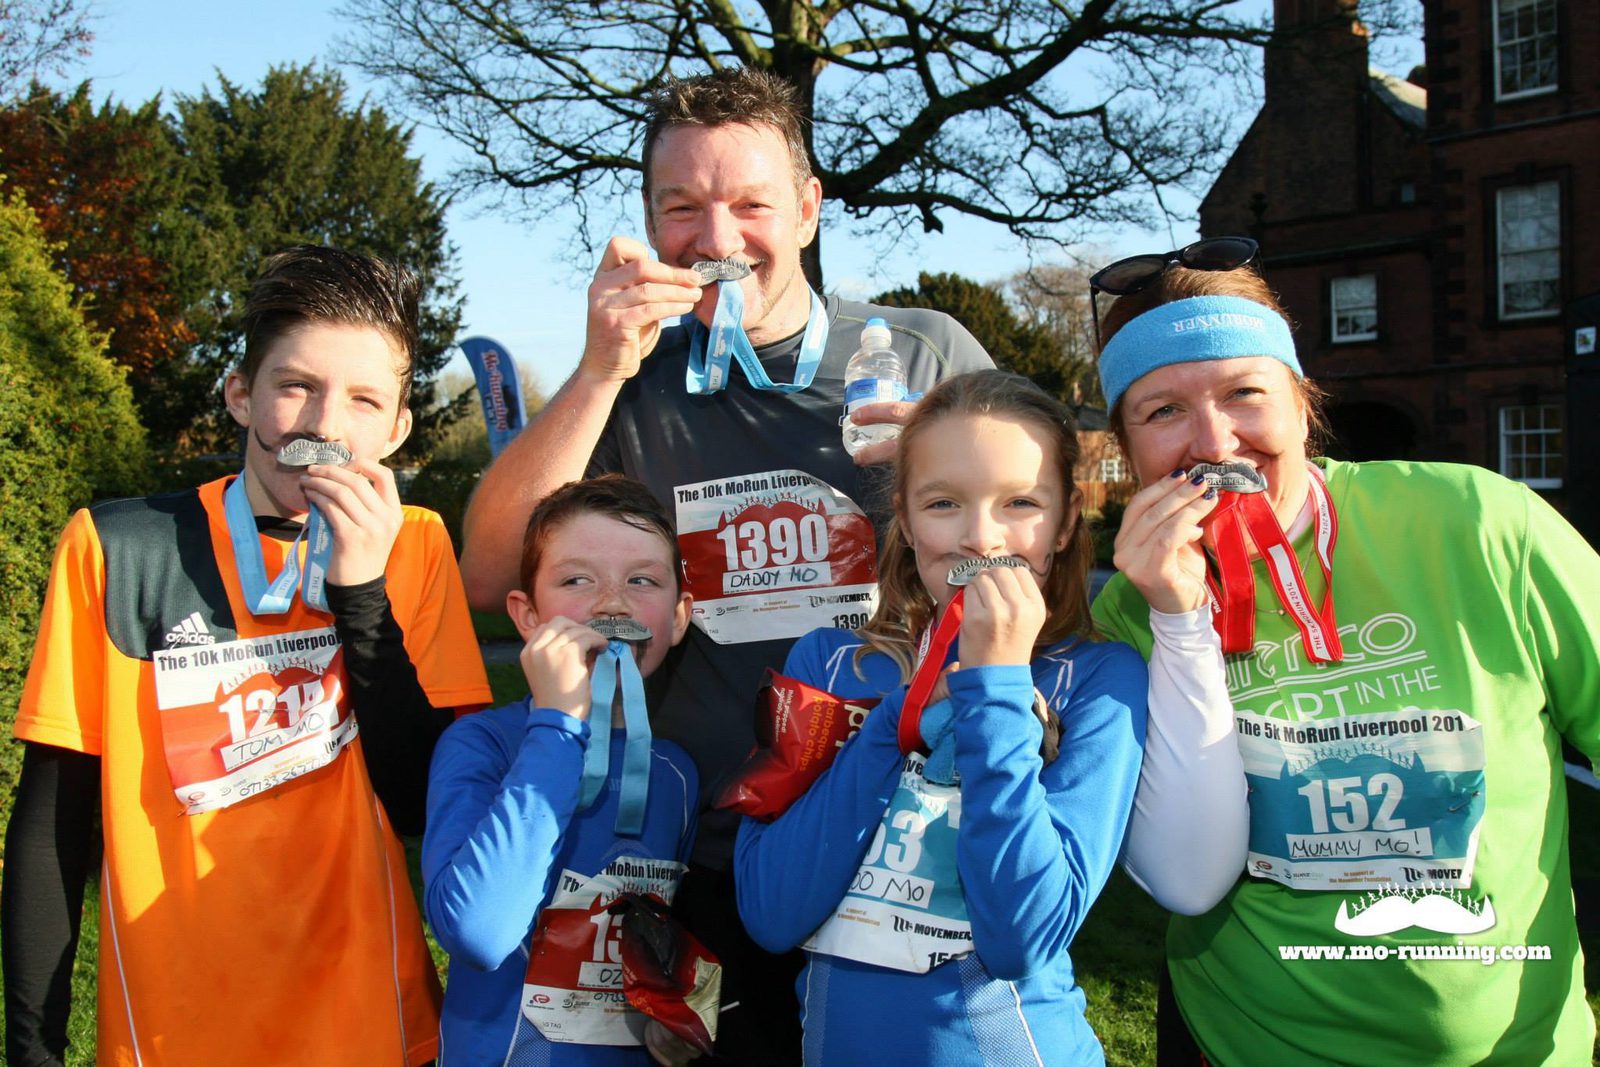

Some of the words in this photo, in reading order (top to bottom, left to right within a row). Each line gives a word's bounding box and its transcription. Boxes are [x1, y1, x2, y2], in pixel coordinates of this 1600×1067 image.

[678, 489, 699, 504] The
[702, 484, 723, 497] 10k
[725, 479, 769, 496] MoRun
[771, 474, 826, 489] Liverp
[1206, 477, 1247, 486] ORUNNER
[716, 513, 829, 571] 1390
[789, 566, 818, 582] MO
[832, 613, 869, 630] 1390
[159, 654, 187, 672] The
[191, 651, 219, 668] 10k
[223, 642, 274, 663] MoRun
[276, 632, 343, 655] Liverpool
[165, 631, 216, 645] adidas
[1314, 635, 1322, 650] THE
[1354, 678, 1385, 705] IN
[1386, 665, 1442, 697] THE
[808, 695, 823, 737] potato
[815, 701, 836, 760] barbeque
[1237, 717, 1261, 737] The
[1264, 720, 1281, 741] 5k
[1283, 725, 1340, 745] MoRun
[1343, 715, 1428, 740] Liverpool
[232, 734, 283, 761] TOM
[294, 712, 324, 737] MO
[800, 739, 815, 771] chips
[1298, 772, 1406, 834] 152
[1292, 839, 1361, 857] MUMMY
[1375, 831, 1422, 854] MO!
[605, 861, 644, 878] MoRun
